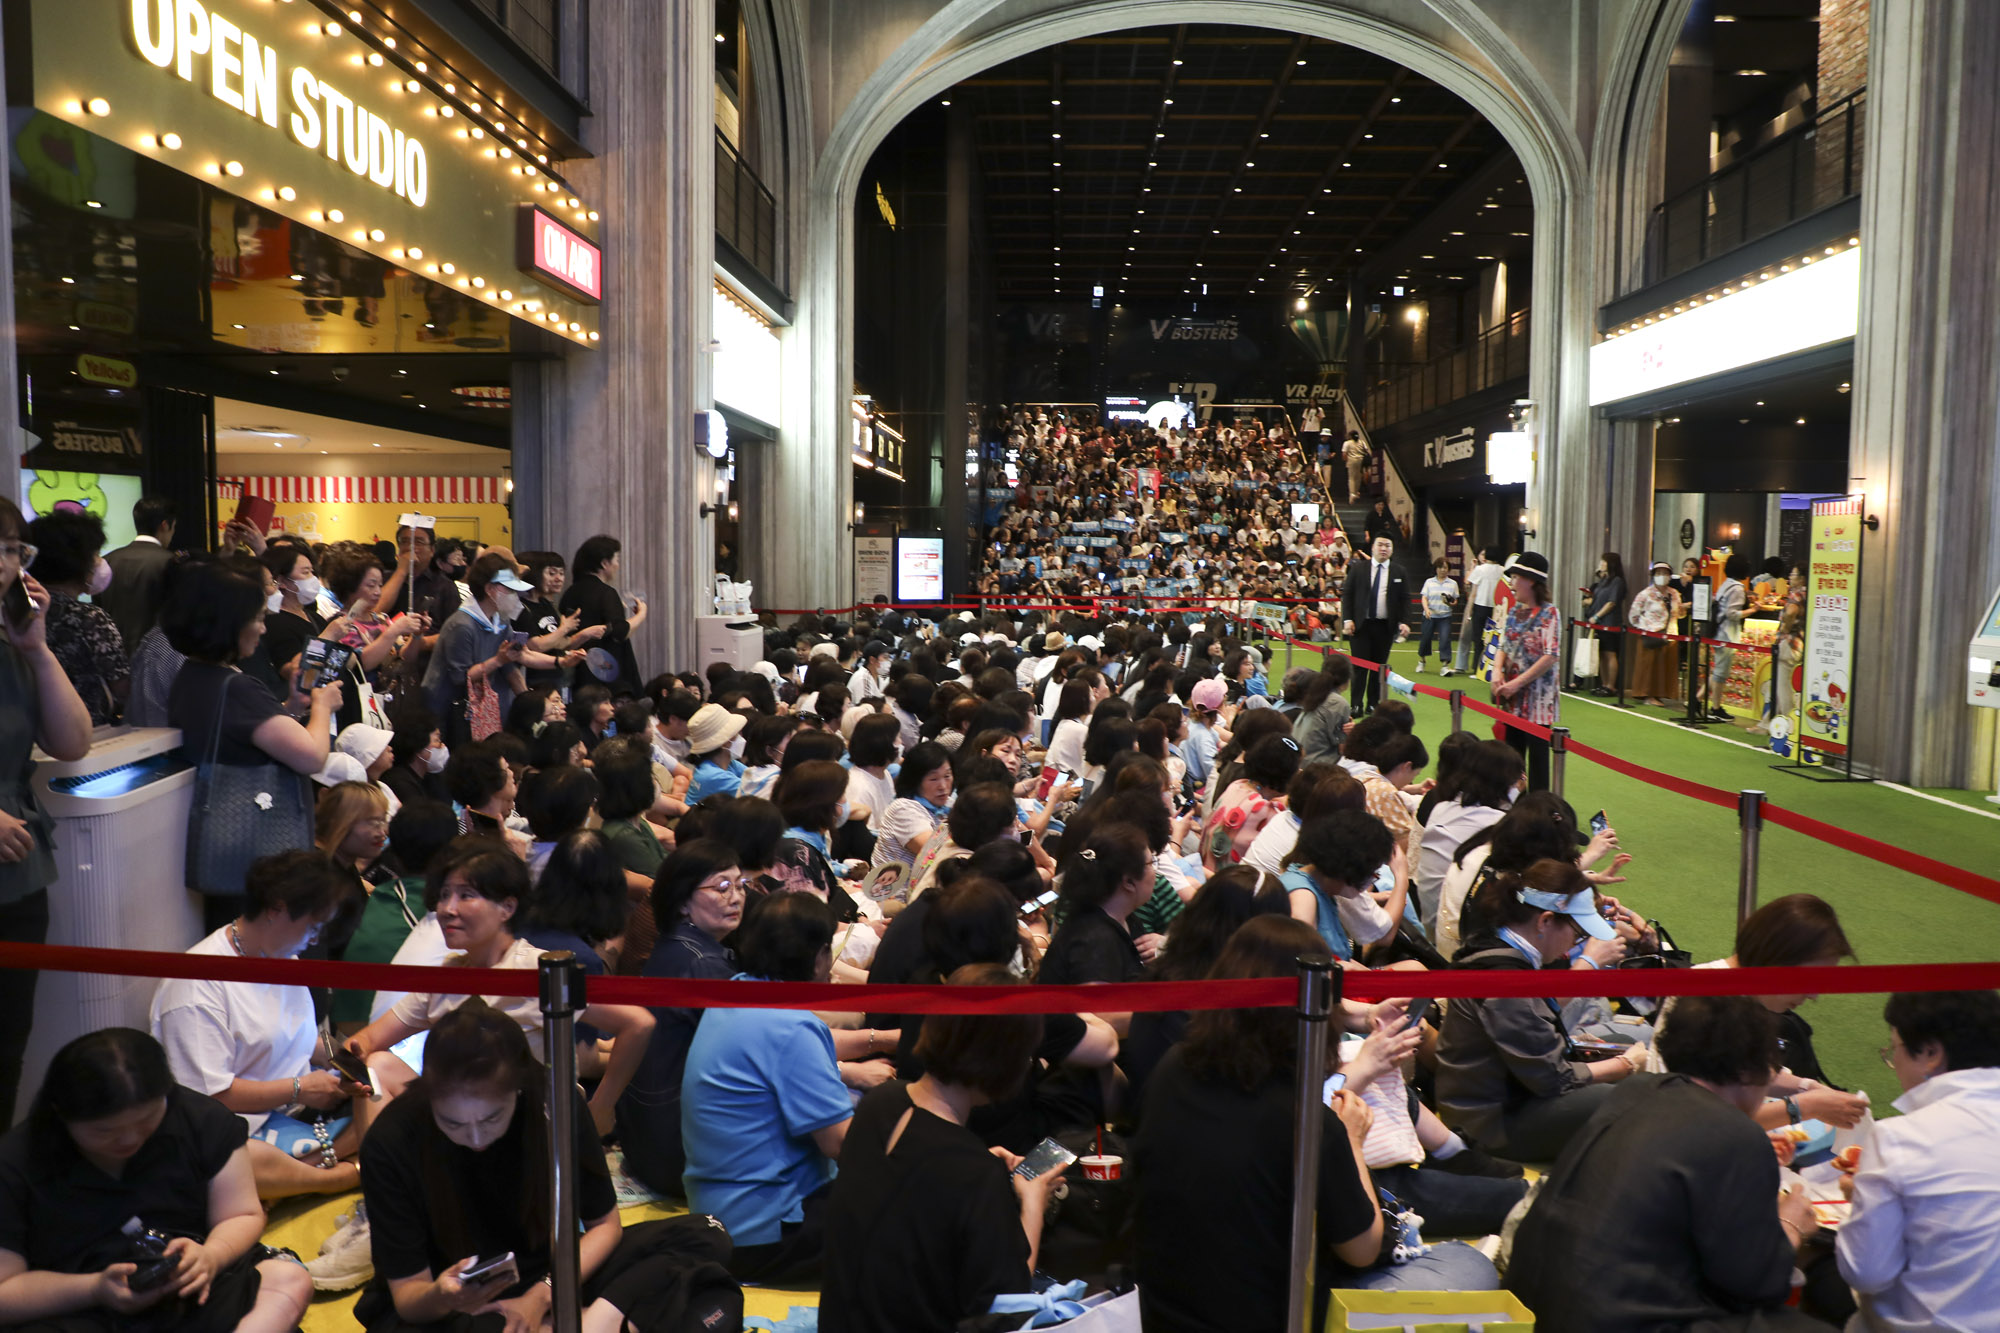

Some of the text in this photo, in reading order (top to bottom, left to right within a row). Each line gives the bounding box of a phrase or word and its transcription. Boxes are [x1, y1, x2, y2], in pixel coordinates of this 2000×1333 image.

[131, 0, 428, 208] OPEN STUDIO
[543, 223, 594, 291] ON AIR
[1170, 327, 1239, 341] BUSTERS
[1285, 384, 1347, 404] VR Play
[1814, 595, 1849, 608] EVENT
